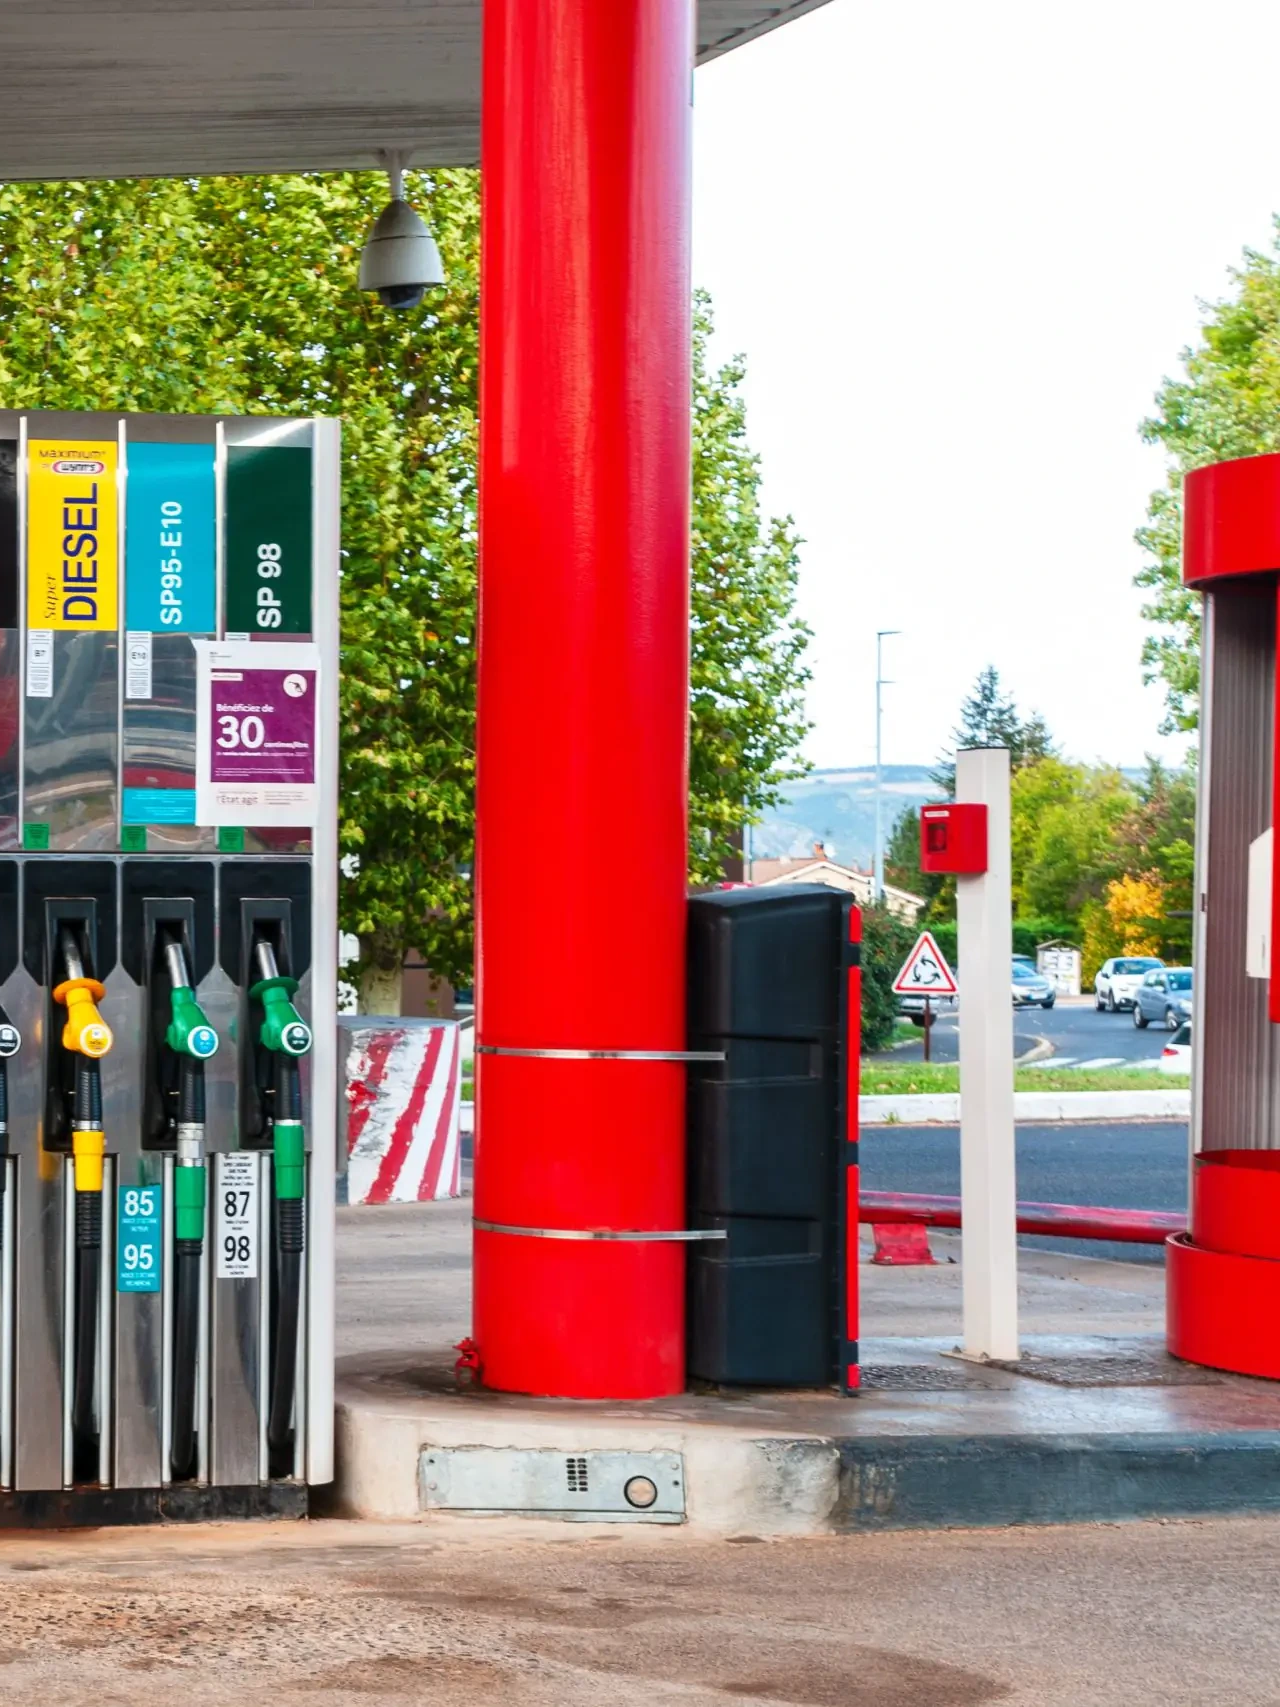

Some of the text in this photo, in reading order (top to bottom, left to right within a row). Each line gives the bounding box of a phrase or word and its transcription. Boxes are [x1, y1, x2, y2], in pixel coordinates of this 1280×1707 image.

[63, 482, 98, 621] DIESEL
[160, 501, 183, 625] SP95-E10
[44, 573, 58, 620] Super
[256, 543, 282, 628] SP 98
[262, 704, 275, 713] de
[216, 715, 265, 749] 30
[124, 1190, 154, 1216] 85
[224, 1191, 250, 1217] 87
[123, 1243, 153, 1270] 95
[224, 1235, 250, 1262] 98
